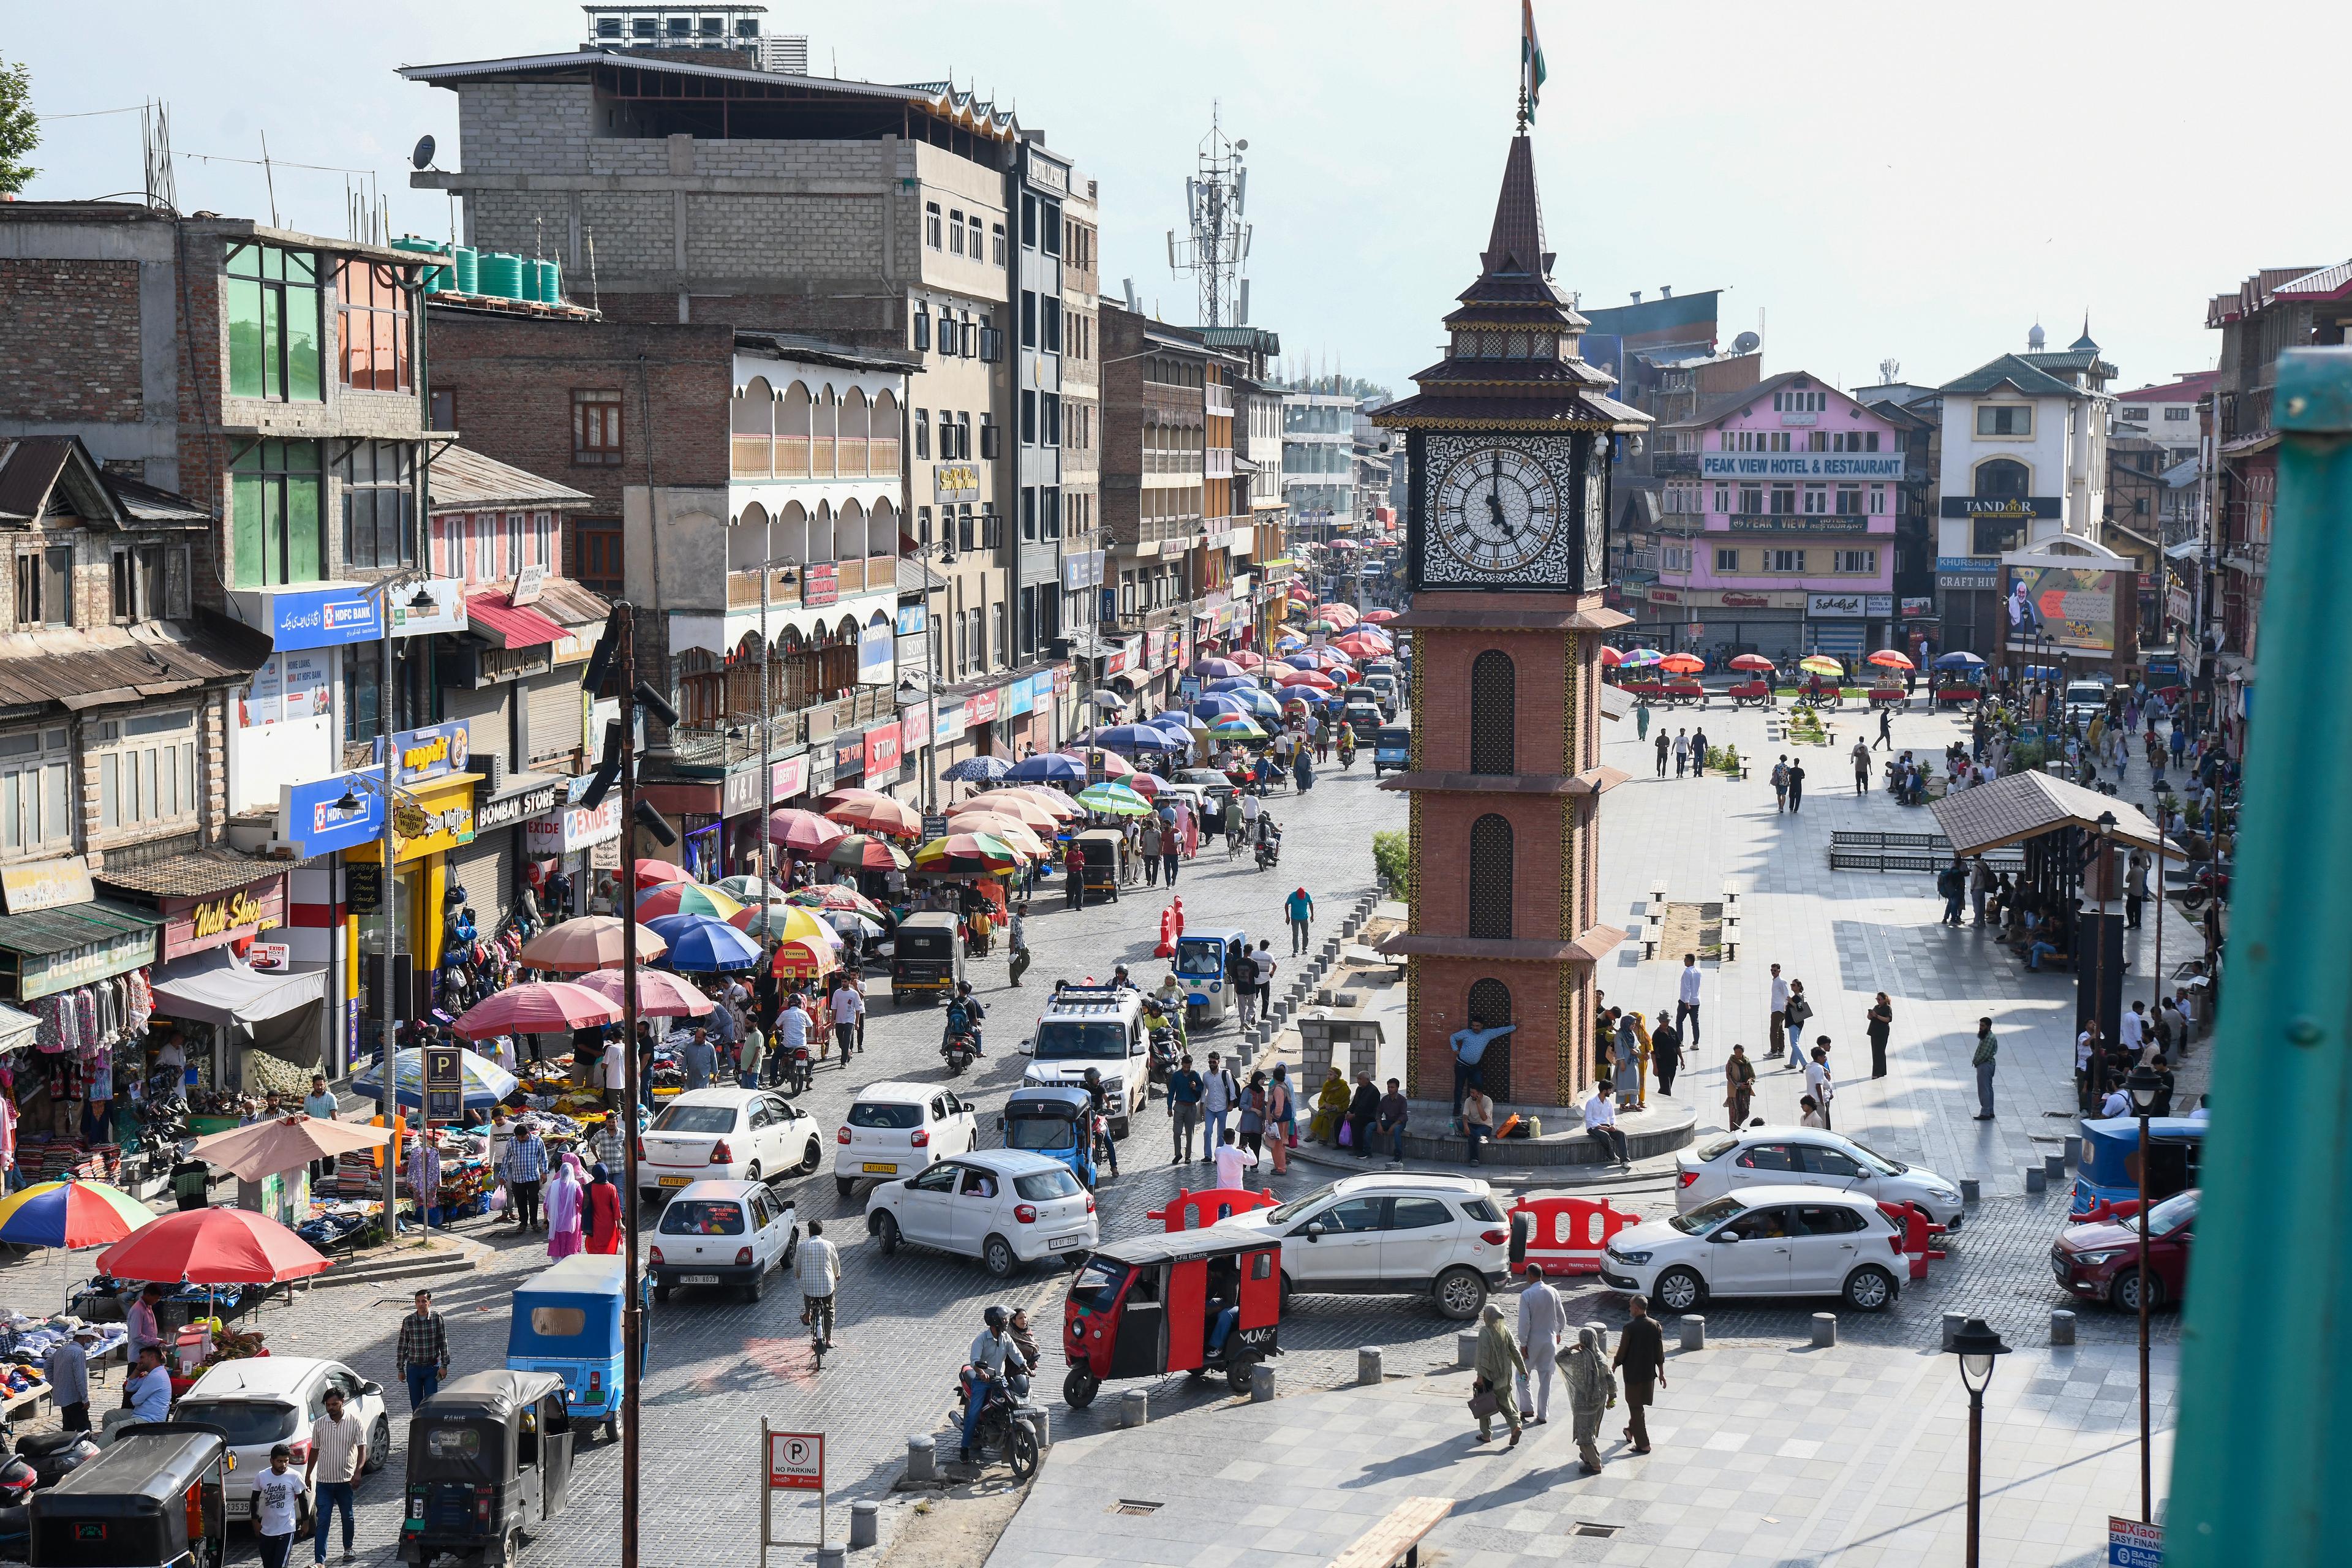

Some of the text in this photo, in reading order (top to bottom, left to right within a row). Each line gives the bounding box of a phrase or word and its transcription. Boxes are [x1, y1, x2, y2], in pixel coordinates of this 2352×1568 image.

[1705, 458, 1901, 475] PEAK VIEW HOTEL & RESTAURANT
[1964, 499, 2031, 513] TANDOOR
[1746, 518, 1807, 529] PEAK VIEW
[522, 568, 542, 582] GROUP-4
[1940, 577, 1973, 587] CRAFT
[519, 584, 540, 595] SUPPLIERS
[1722, 592, 1768, 607] Companion
[335, 606, 371, 621] HDFC BANK
[907, 639, 925, 656] SONY
[287, 659, 311, 669] HOME LOANS,
[288, 674, 296, 682] NOW
[302, 672, 311, 680] HDFC
[312, 670, 322, 679] BANK
[839, 742, 864, 765] ZERO POINT
[881, 737, 896, 760] TITAN
[1093, 755, 1101, 765] P
[774, 765, 796, 786] LIBERTY
[731, 775, 753, 804] U & I
[479, 797, 520, 827] BOMBAY
[524, 788, 555, 813] STORE
[399, 812, 423, 823] Belgian
[443, 807, 471, 834] Waffle CO
[576, 801, 609, 835] EXIDE
[400, 820, 420, 831] Waffle
[529, 821, 559, 834] EXIDE
[353, 873, 374, 882] Lunch
[353, 894, 375, 903] Snacks
[195, 889, 262, 938] Walk Shoes
[48, 929, 150, 979] REGAL SALE
[23, 963, 45, 974] CROWN
[24, 979, 42, 989] HOTEL
[73, 974, 85, 982] LAL
[438, 1057, 450, 1072] P
[792, 1444, 802, 1460] P
[265, 1493, 285, 1502] Jones
[2109, 1533, 2132, 1544] EASY
